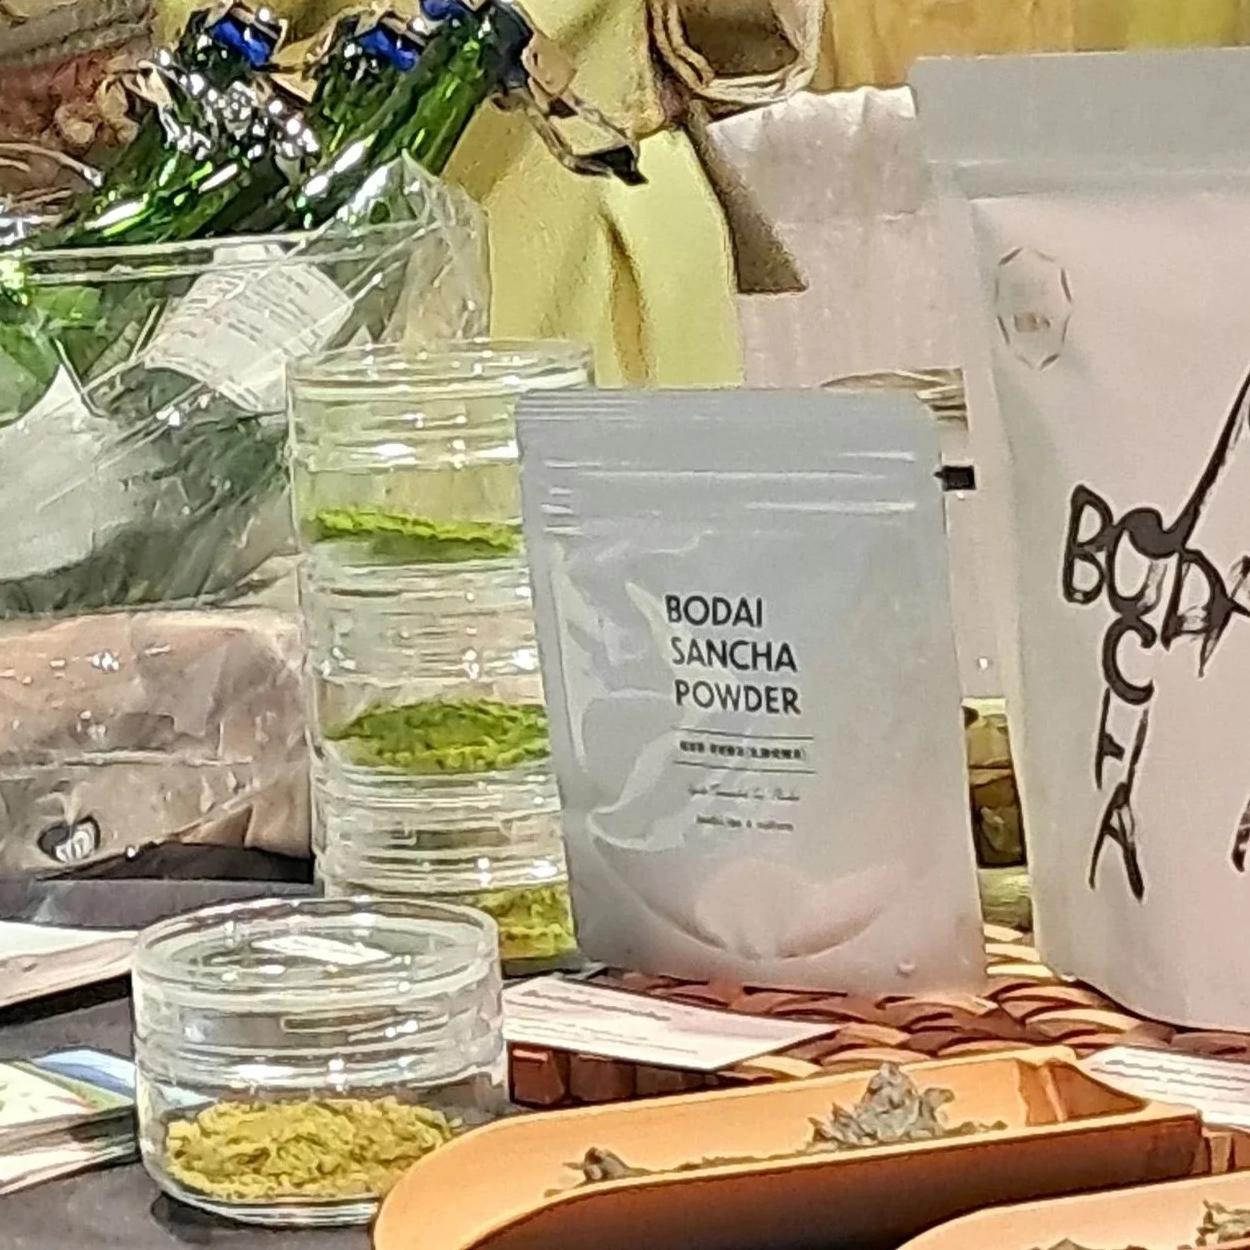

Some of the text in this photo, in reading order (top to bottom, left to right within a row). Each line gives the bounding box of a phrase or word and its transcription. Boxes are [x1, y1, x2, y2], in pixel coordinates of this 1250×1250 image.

[664, 594, 763, 628] BODAI
[670, 636, 798, 673] SANCHA
[674, 679, 802, 716] POWDER
